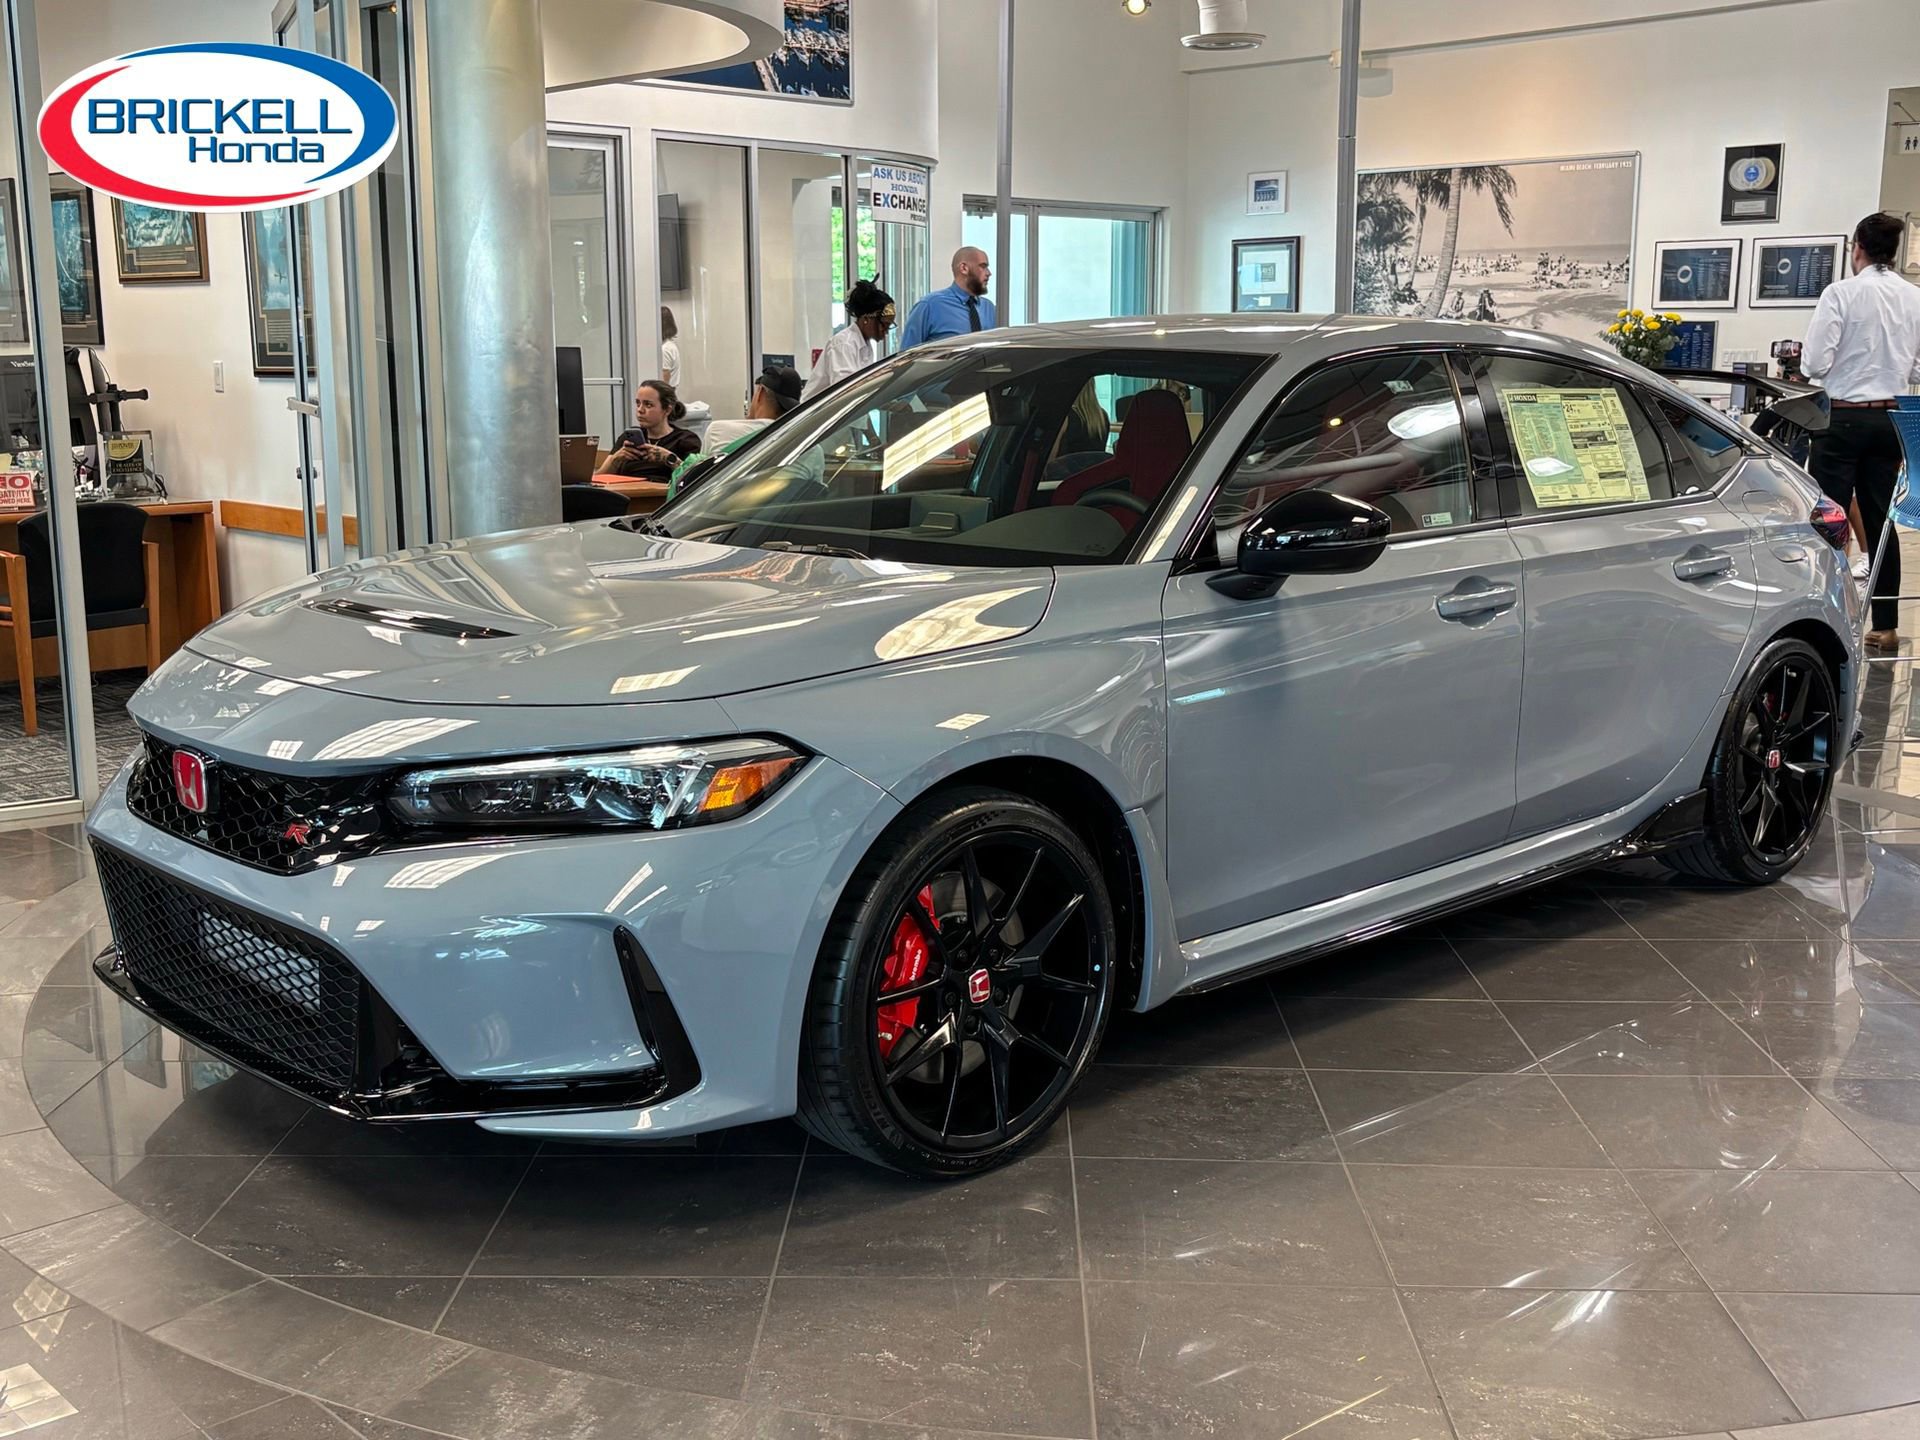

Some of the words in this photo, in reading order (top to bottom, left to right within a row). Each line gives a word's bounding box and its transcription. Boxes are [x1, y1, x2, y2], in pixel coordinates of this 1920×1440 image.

[873, 167, 893, 180] ASK
[895, 170, 907, 181] US
[891, 183, 919, 194] HONDA
[873, 192, 926, 214] EXCHANGE
[909, 949, 922, 981] brembo
